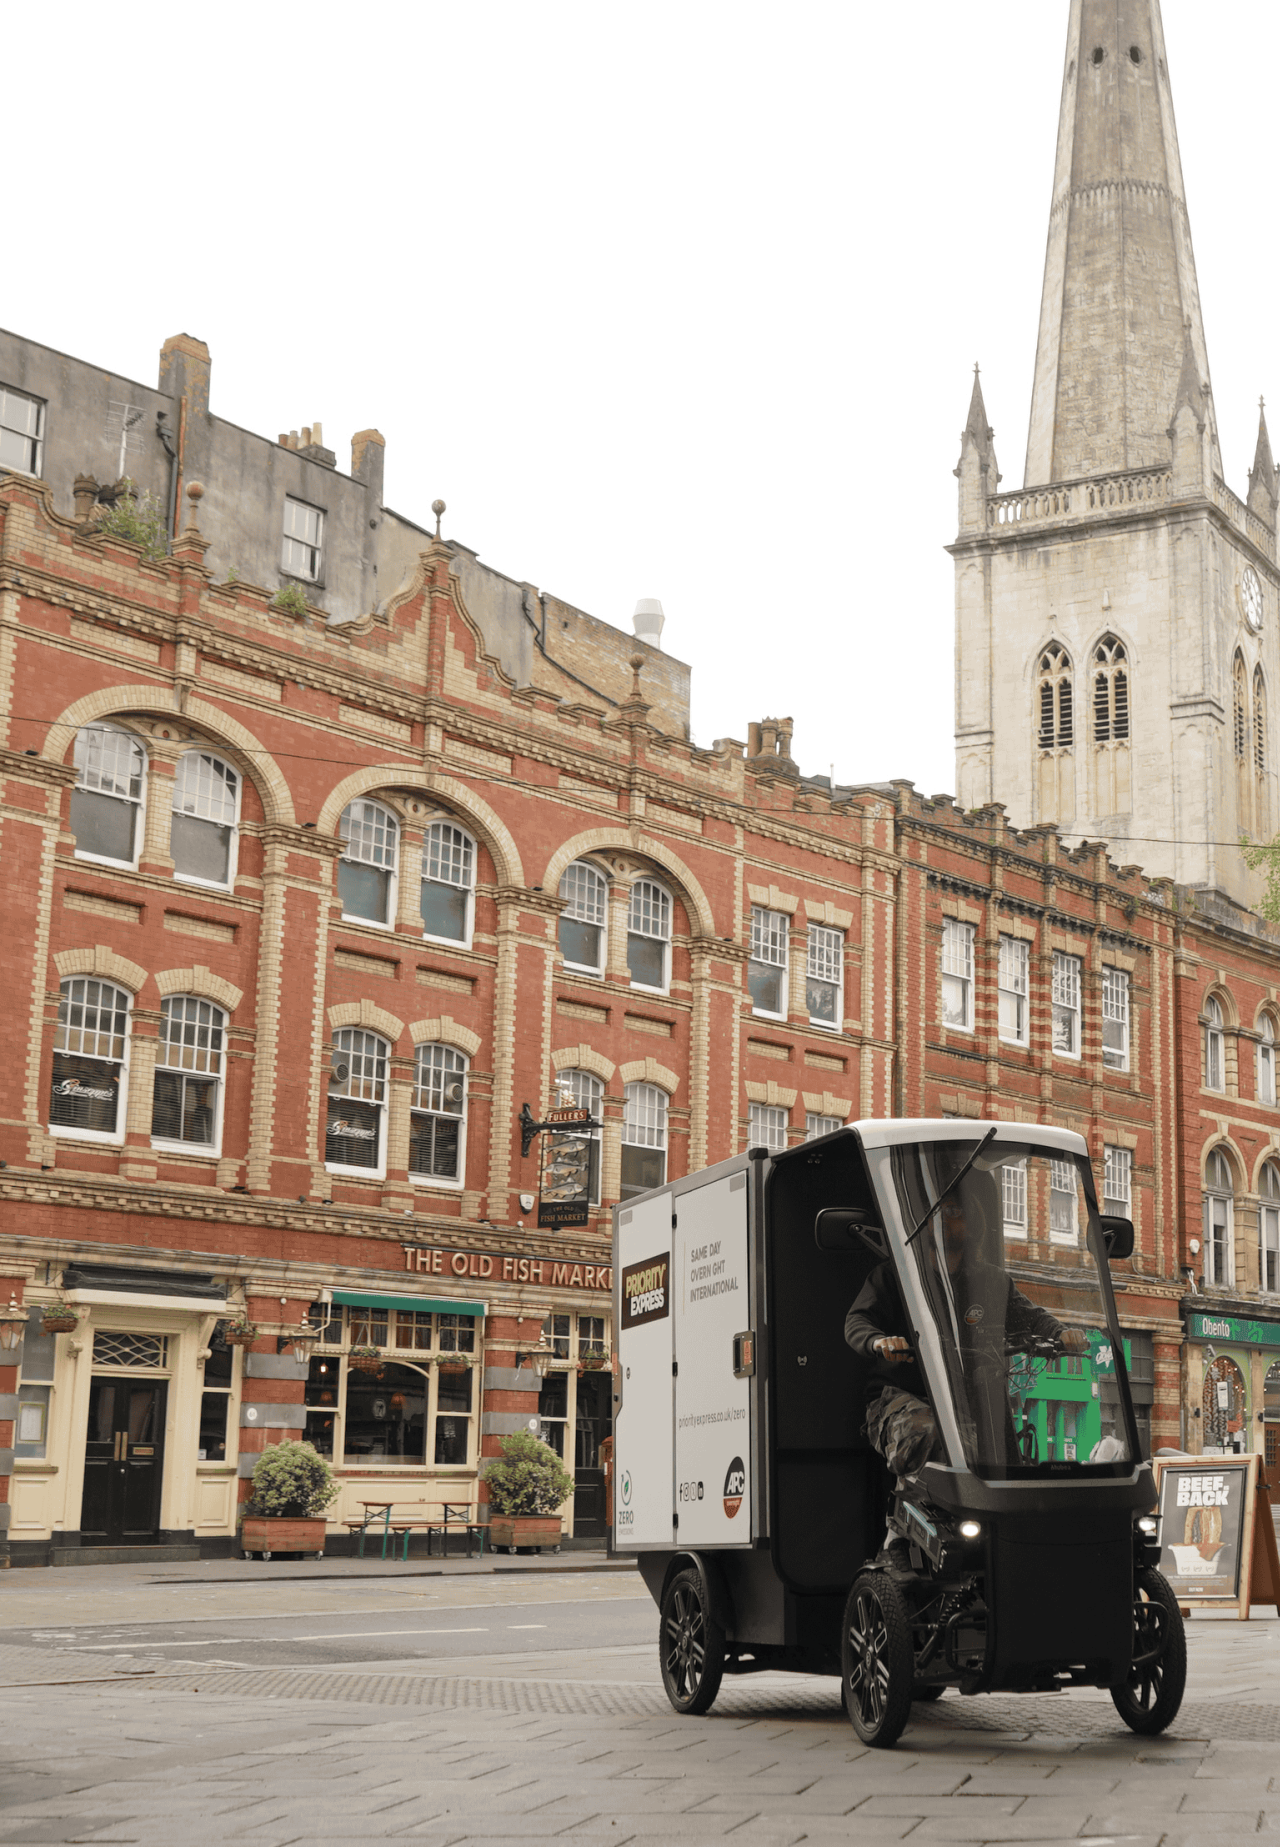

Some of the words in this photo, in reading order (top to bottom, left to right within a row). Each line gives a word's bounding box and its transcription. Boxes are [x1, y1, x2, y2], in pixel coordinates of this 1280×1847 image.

[541, 1215, 556, 1223] FISH
[557, 1213, 586, 1222] MARKET
[691, 1246, 708, 1263] SAME
[709, 1241, 721, 1257] DAY
[404, 1247, 443, 1273] THE
[451, 1252, 493, 1278] OLD
[502, 1257, 544, 1283] FISH
[690, 1259, 726, 1283] OVERNGHT
[625, 1263, 667, 1299] PRIORITY
[690, 1276, 738, 1303] INTERNATIONAL
[630, 1287, 665, 1317] EXPRESS
[968, 1309, 983, 1317] APC
[1203, 1317, 1230, 1338] Obento
[727, 1471, 745, 1494] APC
[1178, 1476, 1230, 1492] BEEF.
[1177, 1490, 1229, 1507] BACK
[618, 1511, 634, 1525] ZERO
